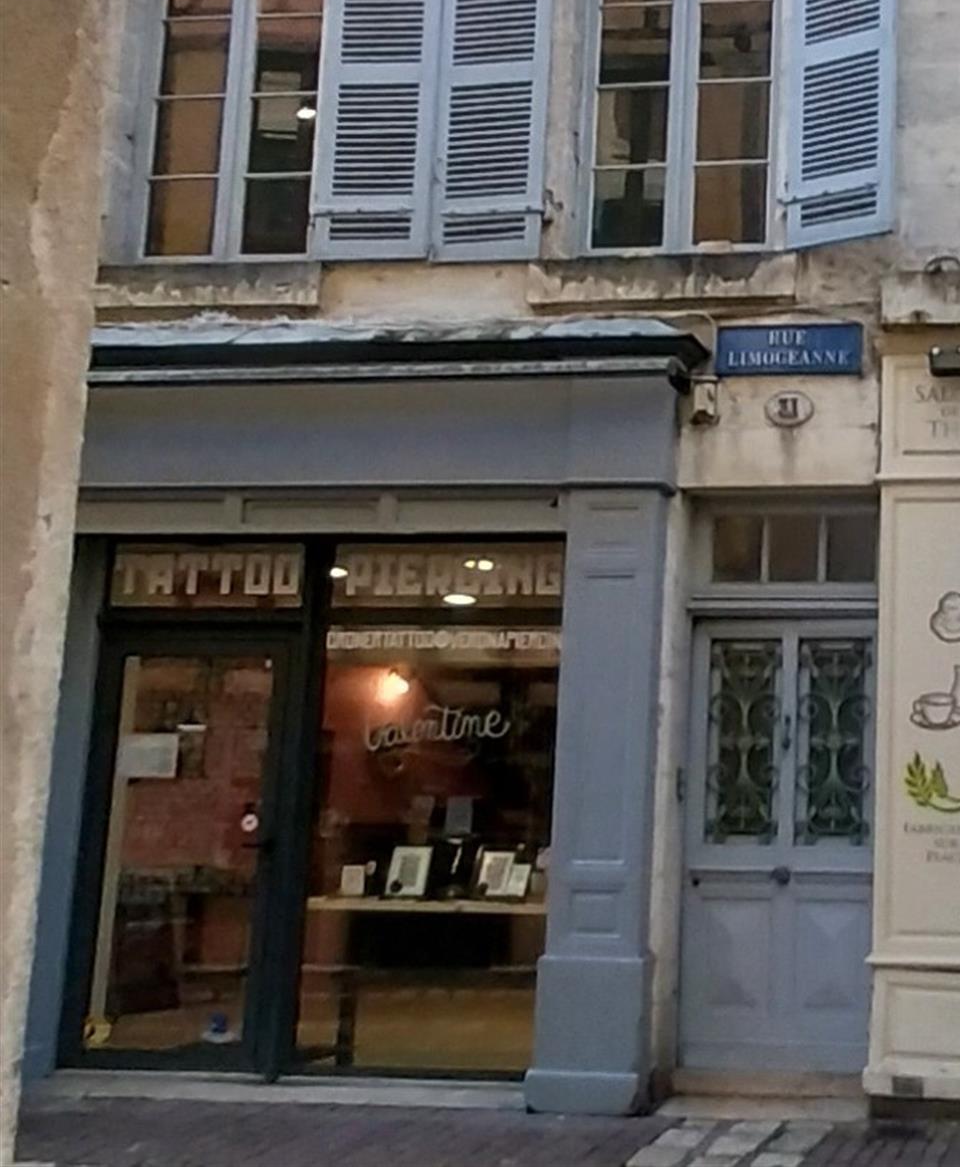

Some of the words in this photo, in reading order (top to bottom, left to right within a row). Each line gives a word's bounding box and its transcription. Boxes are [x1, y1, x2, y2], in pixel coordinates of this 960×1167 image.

[768, 329, 806, 346] RUE
[728, 349, 849, 367] LIMOGEANNE
[114, 552, 300, 596] TATTOO
[345, 551, 562, 597] PIERCING
